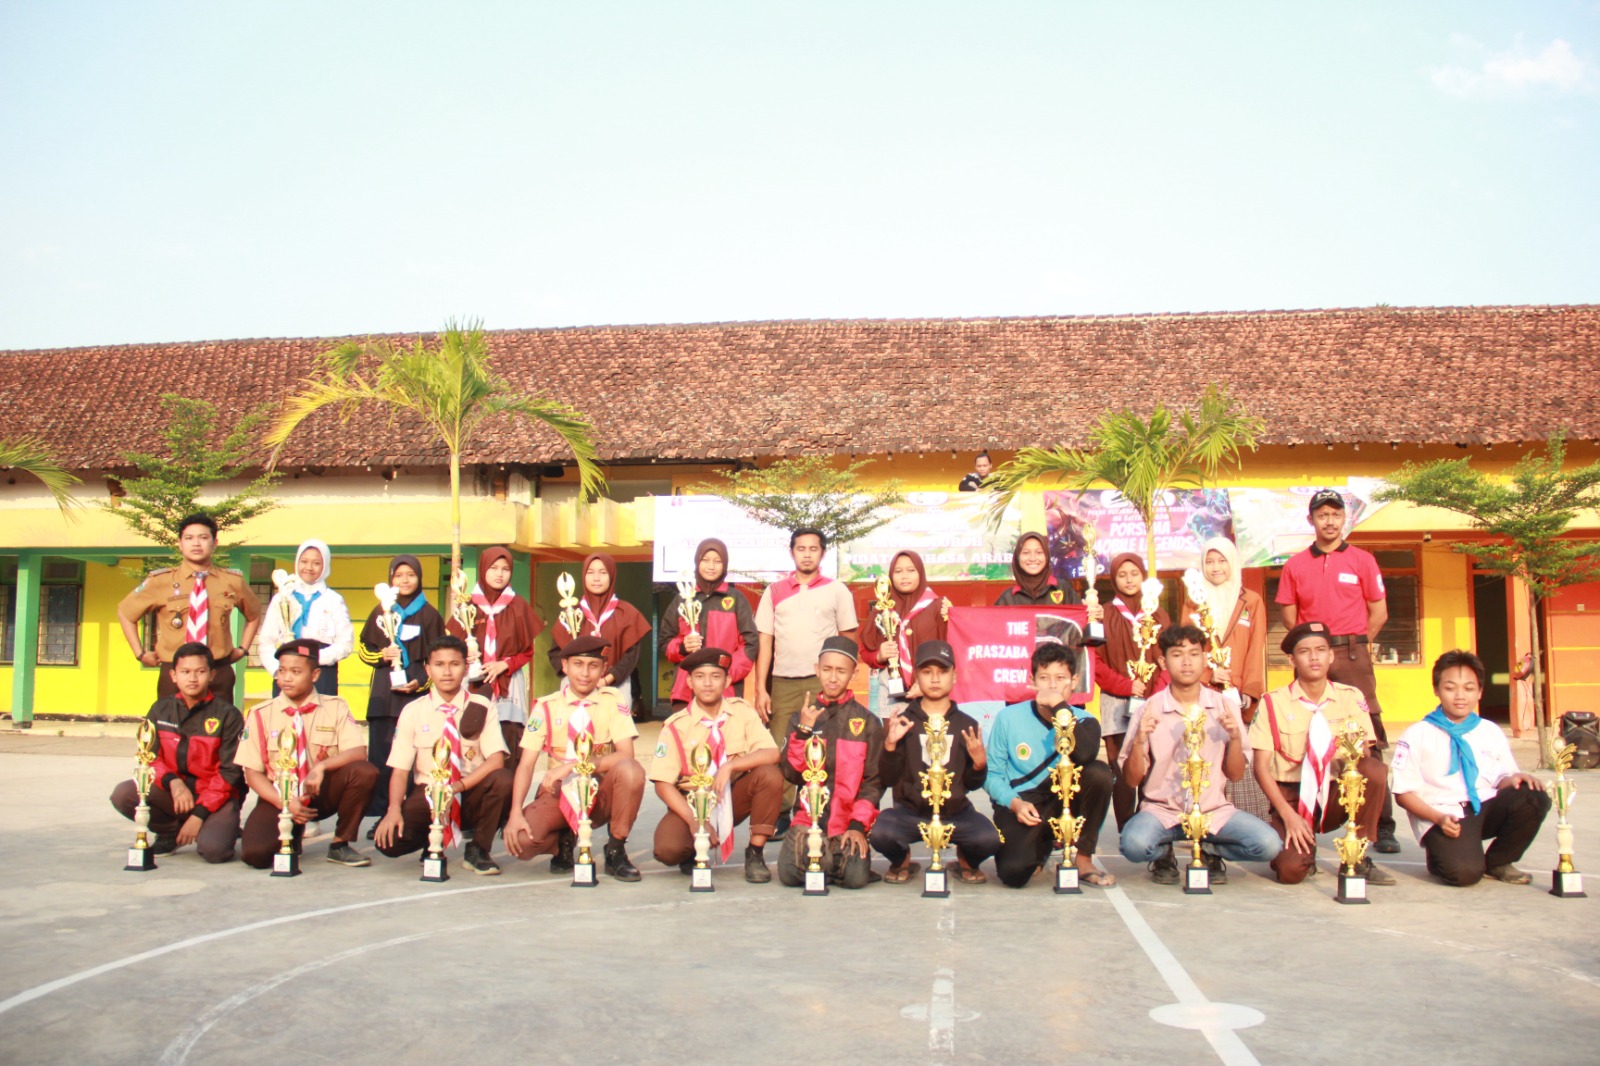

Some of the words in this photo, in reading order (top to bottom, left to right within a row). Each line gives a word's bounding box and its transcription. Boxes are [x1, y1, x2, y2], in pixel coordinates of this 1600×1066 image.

[1110, 521, 1170, 537] PORSMA
[1139, 536, 1193, 552] LGENDS
[843, 553, 889, 565] PIDAT
[1007, 622, 1028, 635] THE
[968, 645, 1028, 660] PRASZABA
[994, 669, 1027, 683] CREW
